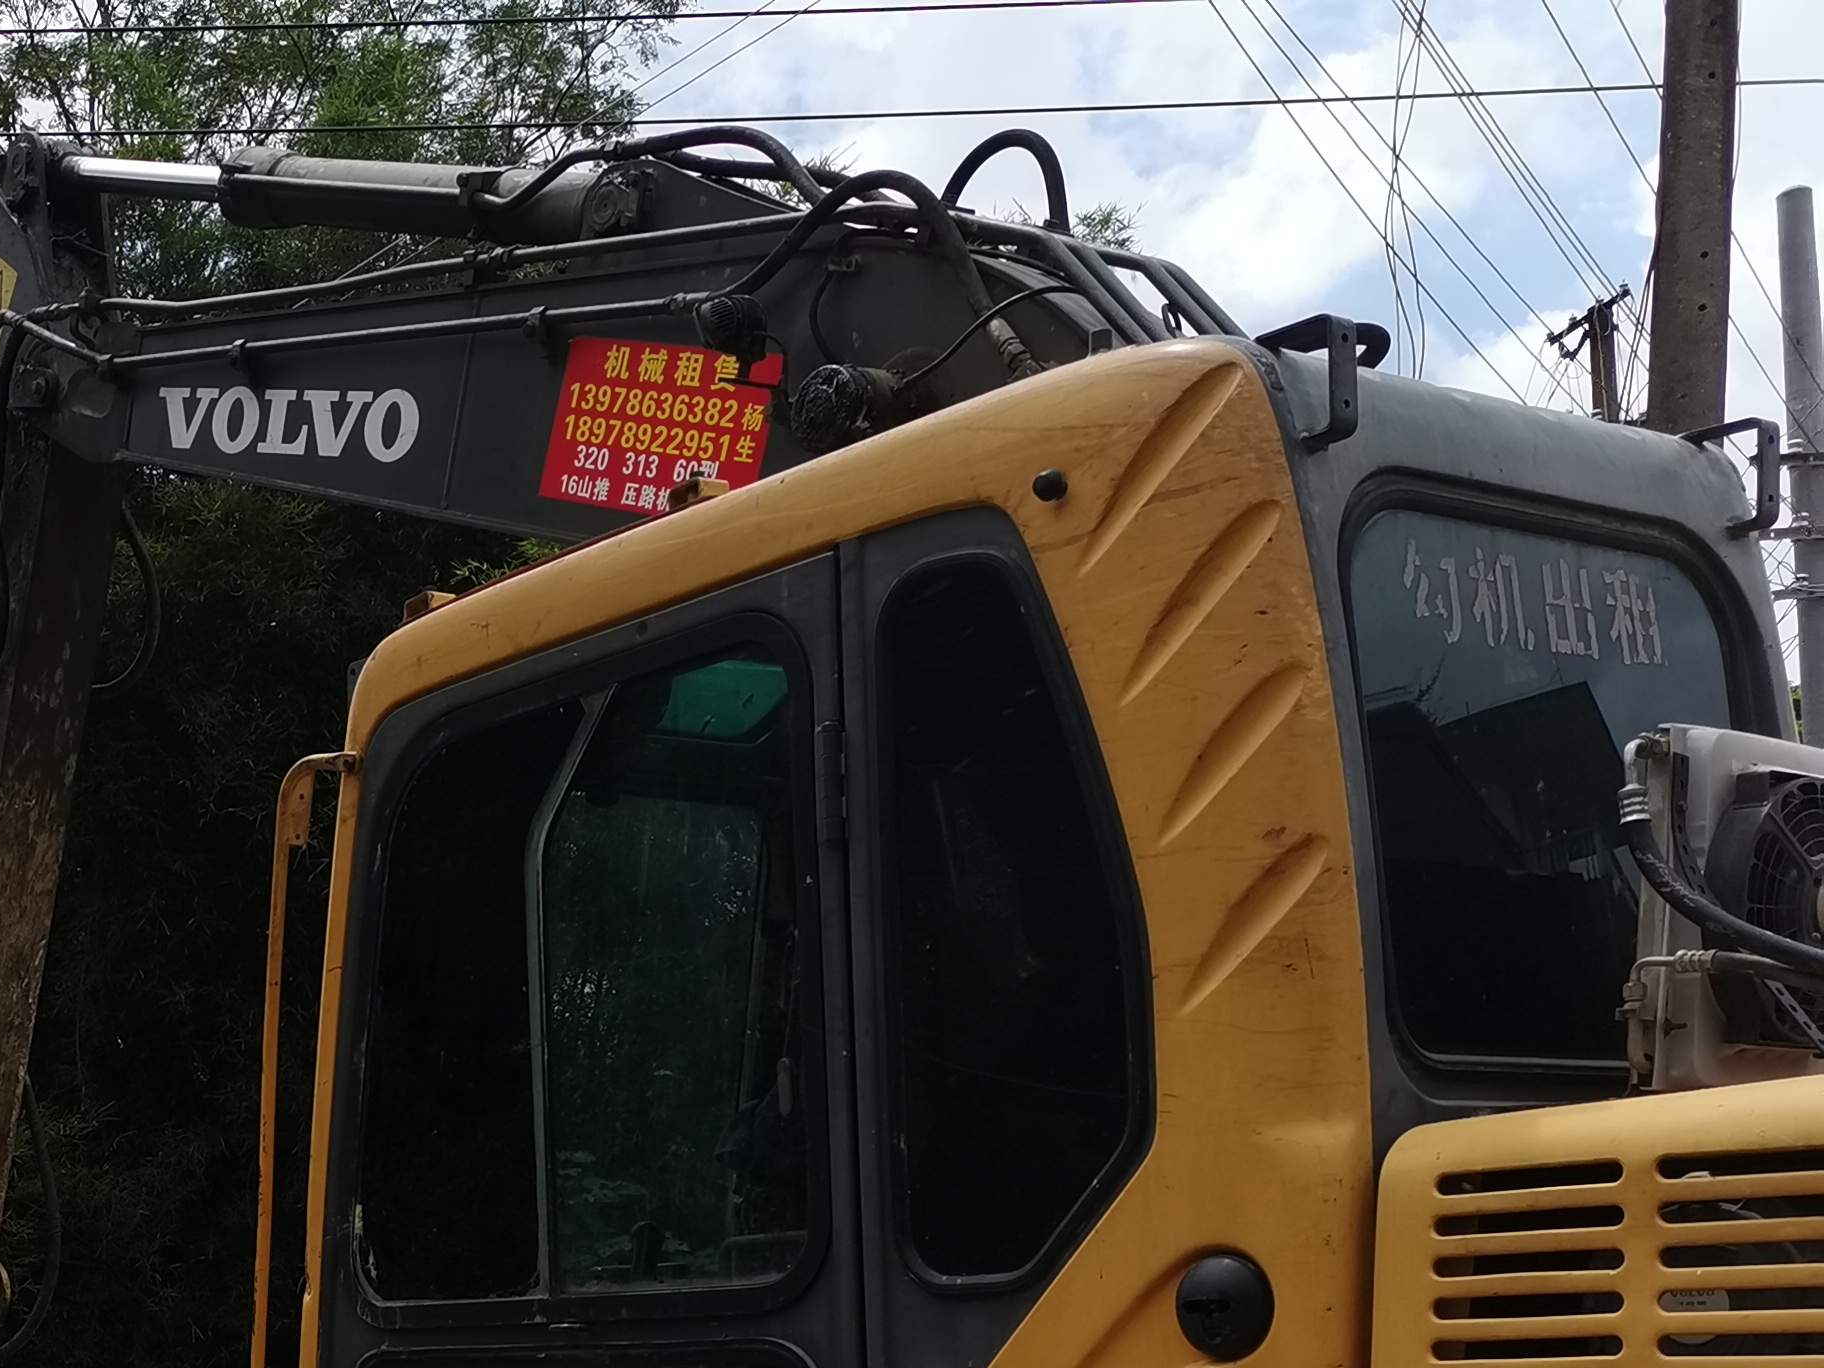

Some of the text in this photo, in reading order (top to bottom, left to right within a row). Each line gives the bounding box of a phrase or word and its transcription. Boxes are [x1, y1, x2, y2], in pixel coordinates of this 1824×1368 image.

[603, 344, 740, 393] 机械租赁
[158, 385, 420, 463] VOLVO
[569, 382, 739, 428] 13978636382
[563, 414, 731, 462] 18978922951
[574, 445, 610, 471] 320
[622, 452, 659, 479] 313
[560, 474, 611, 502] 16山推
